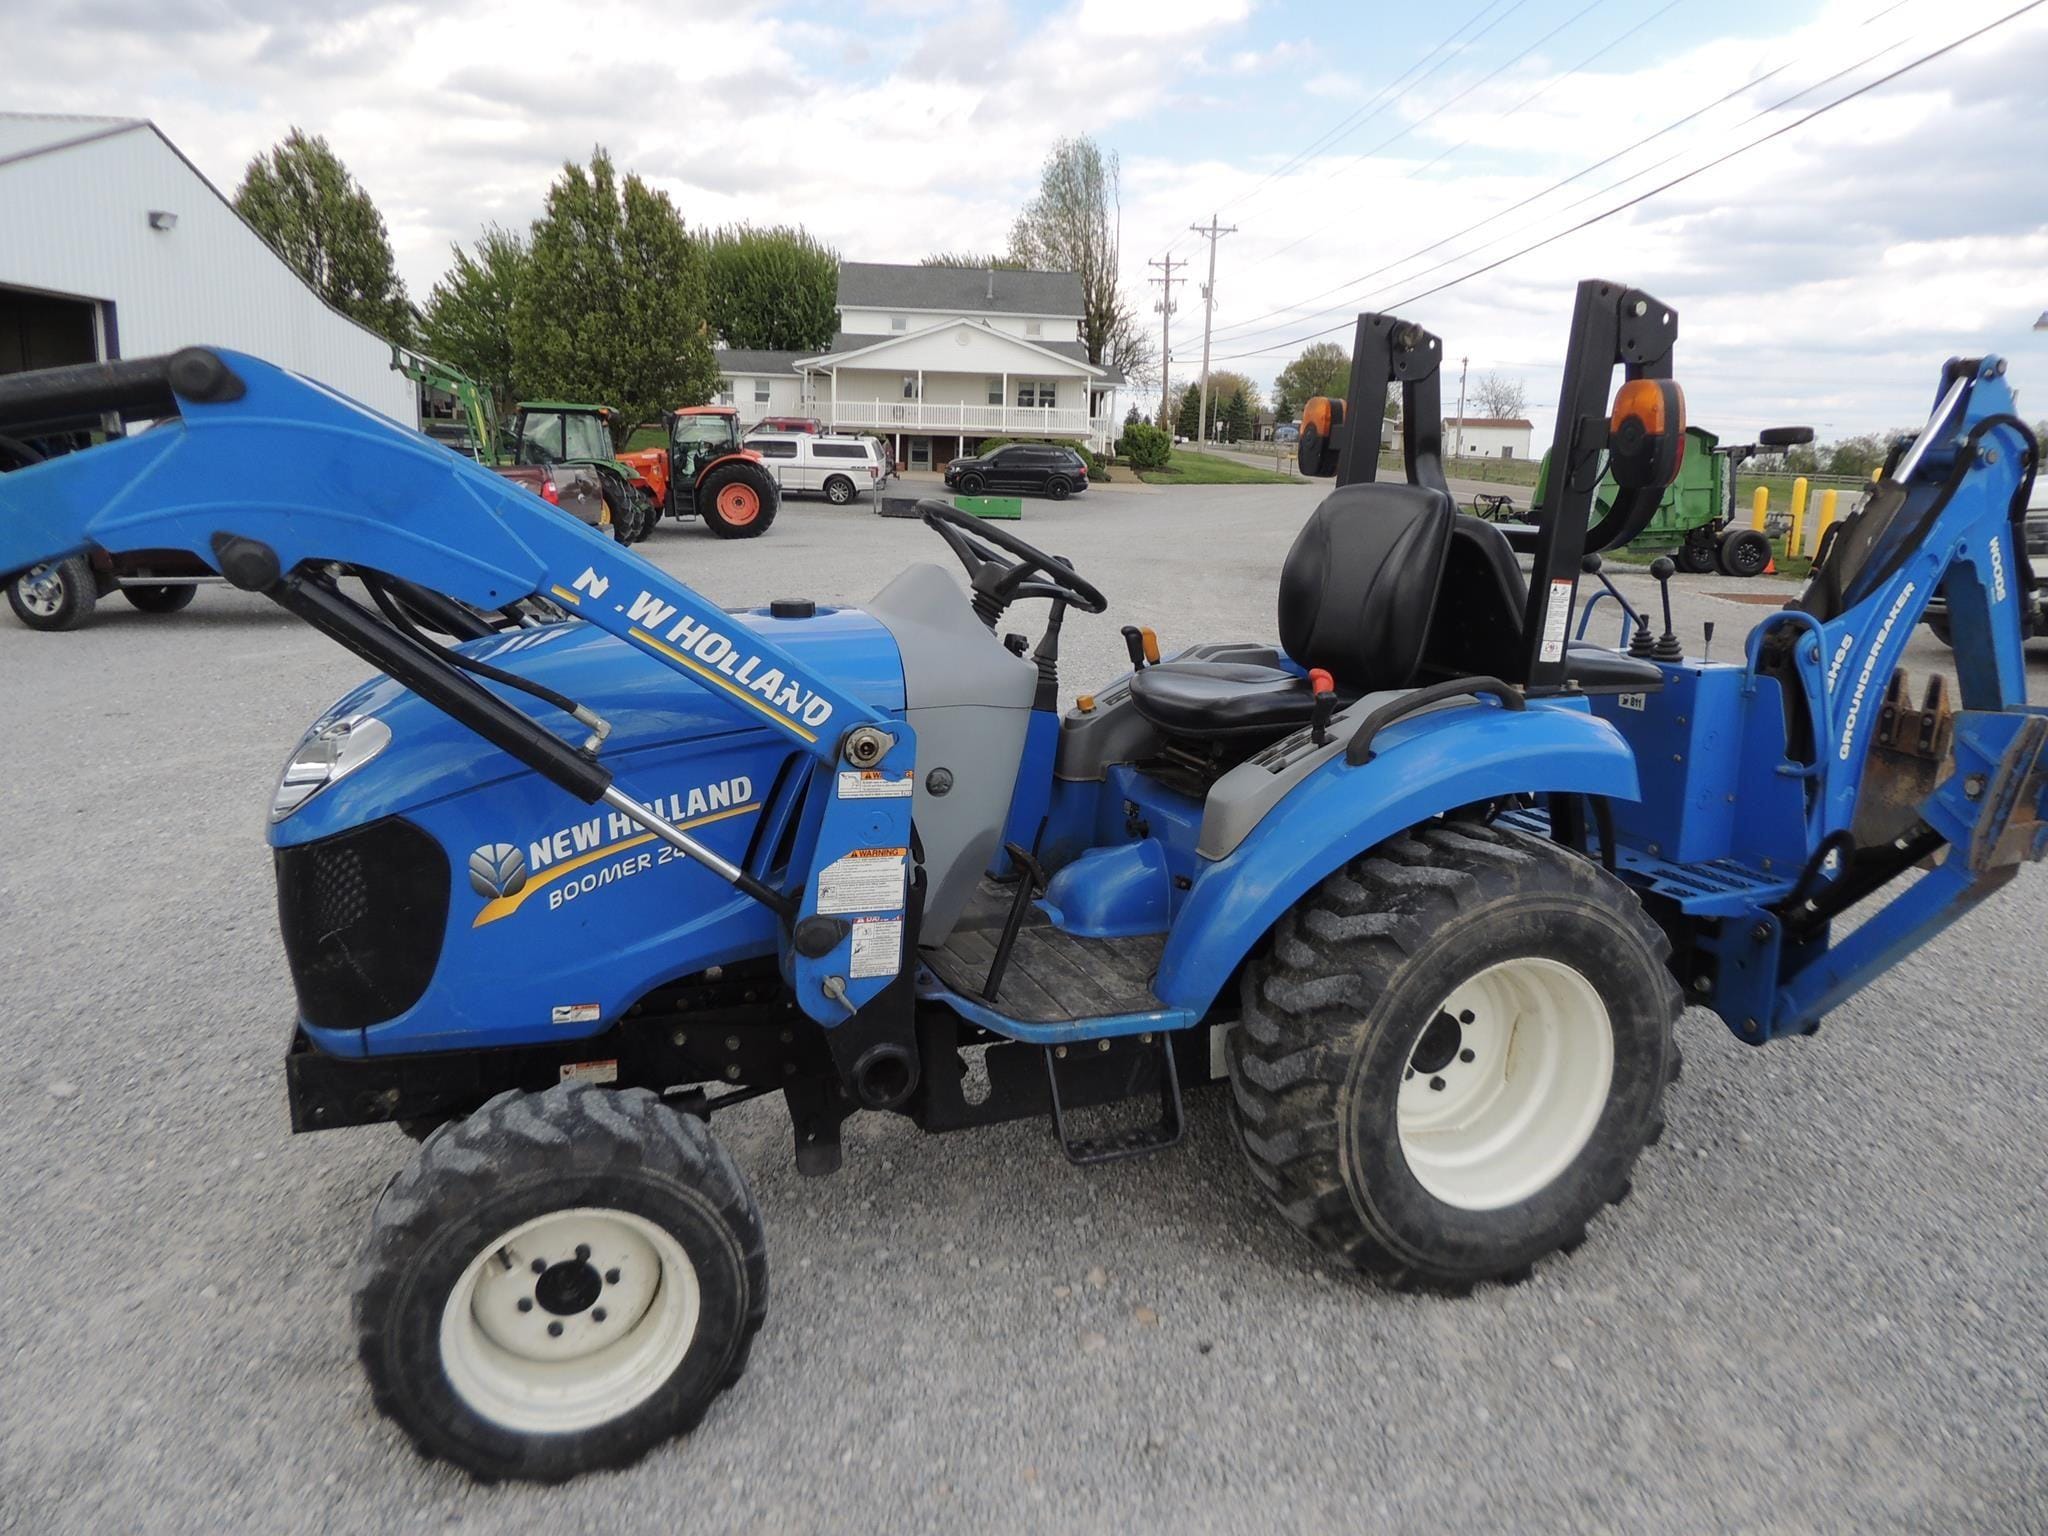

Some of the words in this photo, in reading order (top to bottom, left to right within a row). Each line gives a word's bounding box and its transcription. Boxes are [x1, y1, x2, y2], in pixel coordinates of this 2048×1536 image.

[572, 566, 677, 629] NW
[666, 616, 832, 727] HOLLAND
[1839, 581, 1916, 761] GROUNDBREAKER
[530, 816, 601, 870] NEW
[859, 848, 899, 858] WARNING
[549, 852, 652, 910] BOOMER
